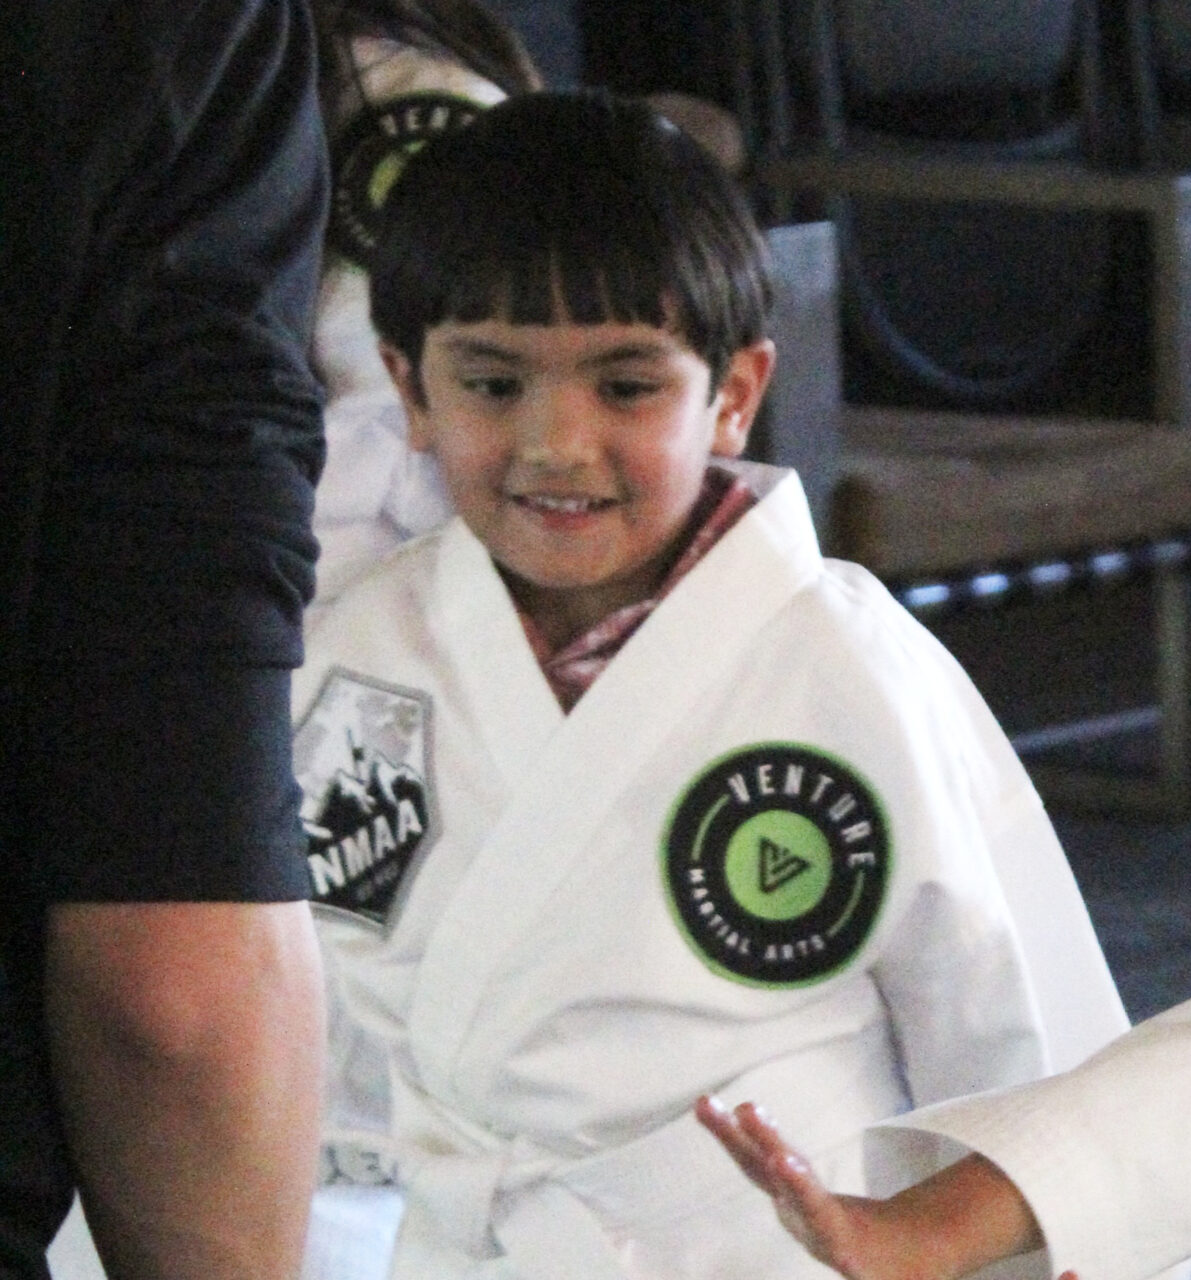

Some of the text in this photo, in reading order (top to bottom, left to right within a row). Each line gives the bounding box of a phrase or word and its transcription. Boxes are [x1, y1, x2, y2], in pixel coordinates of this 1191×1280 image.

[307, 799, 423, 896] NMAA
[727, 764, 876, 869] VENTURE
[764, 934, 826, 961] ARTS
